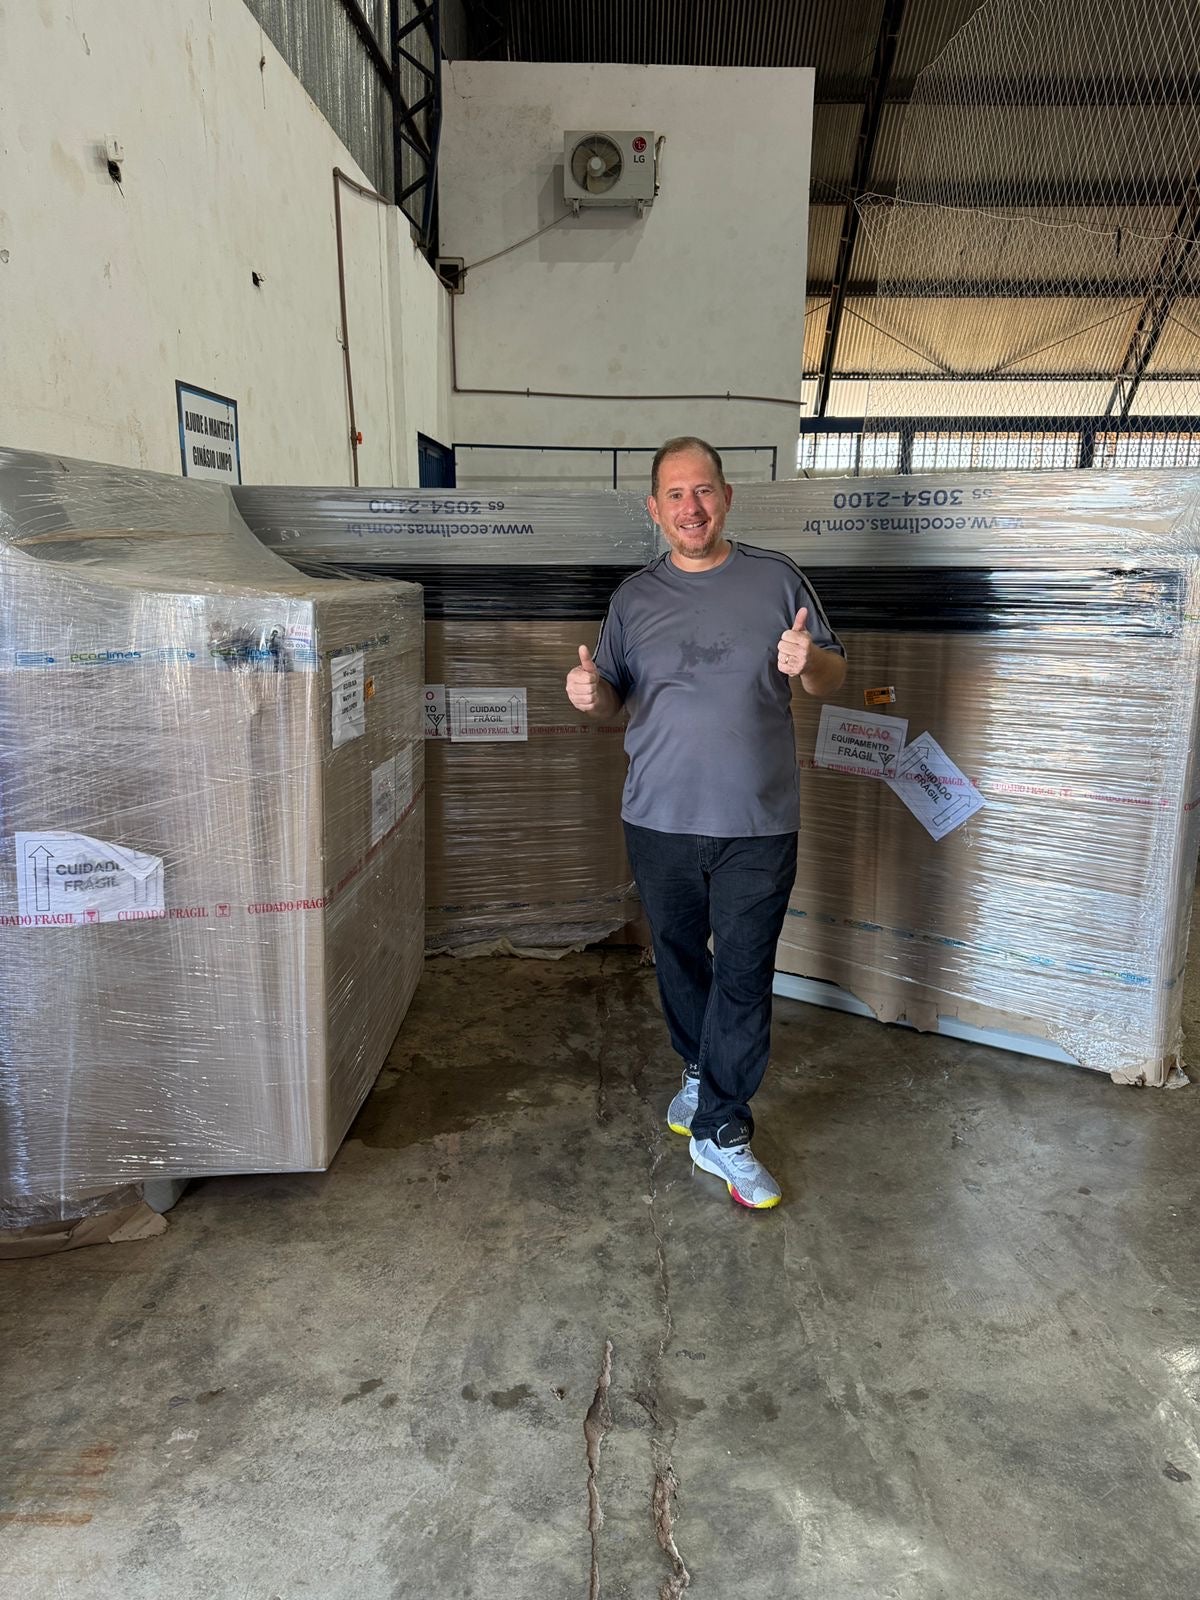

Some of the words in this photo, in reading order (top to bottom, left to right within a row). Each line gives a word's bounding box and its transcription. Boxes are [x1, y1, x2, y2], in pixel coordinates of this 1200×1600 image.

[634, 155, 645, 163] LG
[185, 411, 204, 434] AJUDE
[204, 416, 209, 436] A
[209, 418, 230, 441] MANTER
[230, 424, 234, 442] O
[192, 444, 216, 469] GINÁSIO
[216, 451, 233, 472] LIMPO
[369, 500, 482, 515] 3054-2100
[488, 501, 505, 511] 65
[833, 489, 963, 509] 3054-2100
[345, 523, 534, 537] www.ecoclimas.com.br
[70, 650, 142, 662] ecoclimas
[473, 714, 503, 722] FRÁGIL
[461, 727, 487, 735] CUIDADO
[839, 721, 890, 740] ATENÇÃO
[831, 734, 889, 752] EQUIPAMENTO
[914, 773, 940, 805] FRÁGIL
[920, 763, 952, 800] CUIDADO
[34, 911, 77, 926] FRÁGIL
[118, 909, 166, 921] CUIDADO
[169, 906, 209, 919] FRÁGIL
[247, 901, 294, 915] CUIDADO
